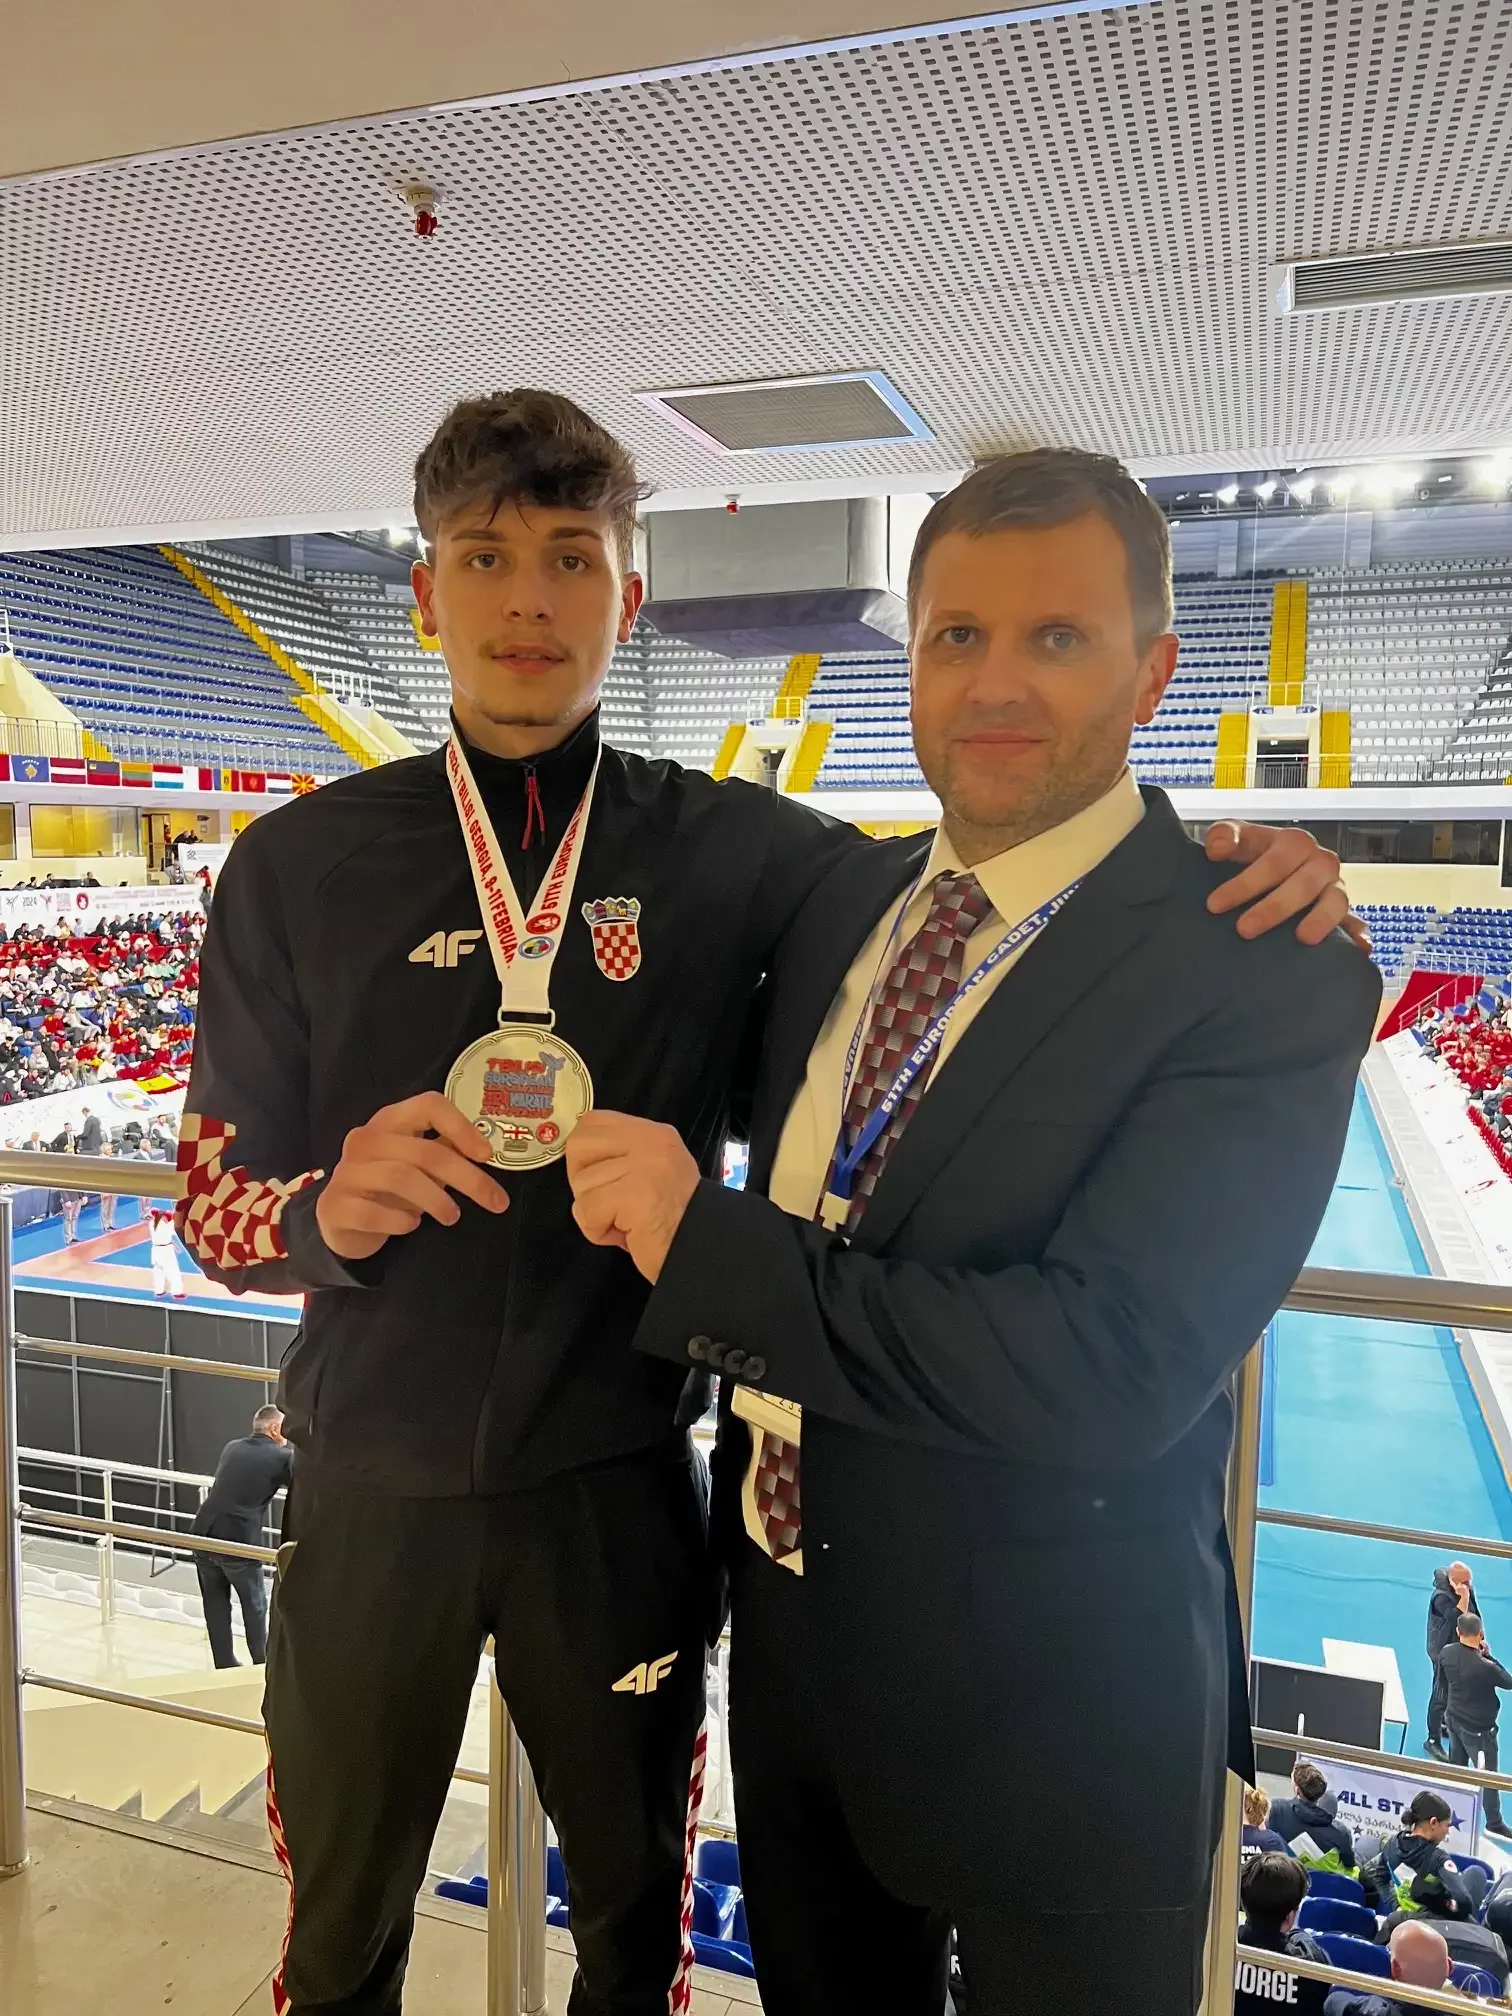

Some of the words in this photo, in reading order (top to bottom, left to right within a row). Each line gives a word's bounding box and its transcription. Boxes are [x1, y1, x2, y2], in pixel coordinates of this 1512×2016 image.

[456, 774, 477, 826] TBILISI,
[468, 819, 493, 882] GEORGIA,
[408, 929, 484, 968] 4F
[881, 1067, 913, 1114] 51TH
[986, 912, 1049, 965] CADET,
[611, 1650, 679, 1695] 4F
[1337, 1790, 1373, 1809] ALL
[1377, 1797, 1404, 1815] ST
